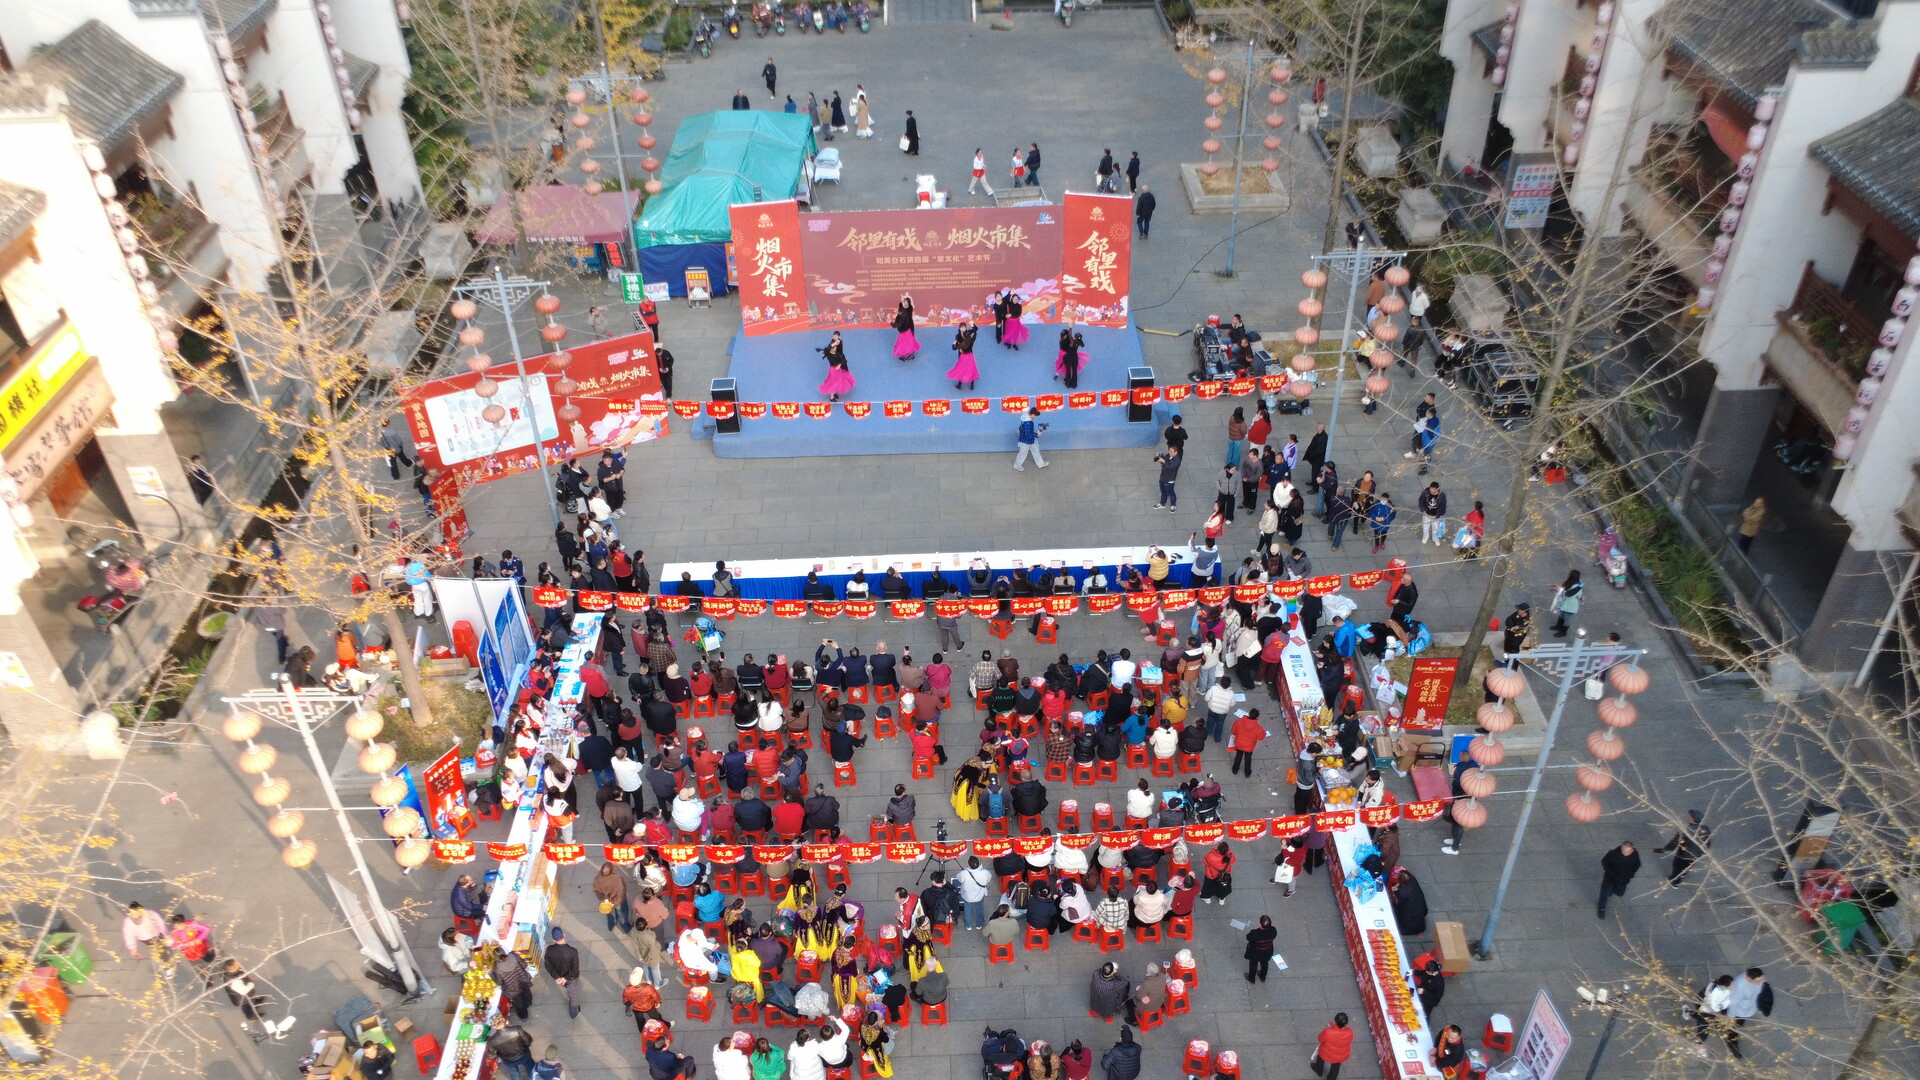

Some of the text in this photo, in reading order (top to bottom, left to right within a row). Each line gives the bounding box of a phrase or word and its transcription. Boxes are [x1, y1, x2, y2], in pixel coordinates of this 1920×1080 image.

[836, 227, 922, 253] 邻里有戏
[945, 225, 1032, 251] 烟火市集
[754, 236, 793, 298] 烟火市集
[1077, 230, 1118, 295] 邻里有戏
[624, 275, 641, 300] 弹棉花
[610, 365, 652, 386] 烟火市集
[1309, 580, 1340, 590] 东北大饼
[1235, 587, 1266, 596] 中国联通
[1276, 819, 1306, 831] 听雨轩
[1316, 815, 1354, 827] 中国电信
[1152, 832, 1172, 841] 甜酒
[1185, 827, 1223, 838] 飞鹤奶粉
[1102, 835, 1139, 844] 丽人日化
[758, 850, 786, 859] 好孝心
[890, 848, 921, 856] 十元快剪
